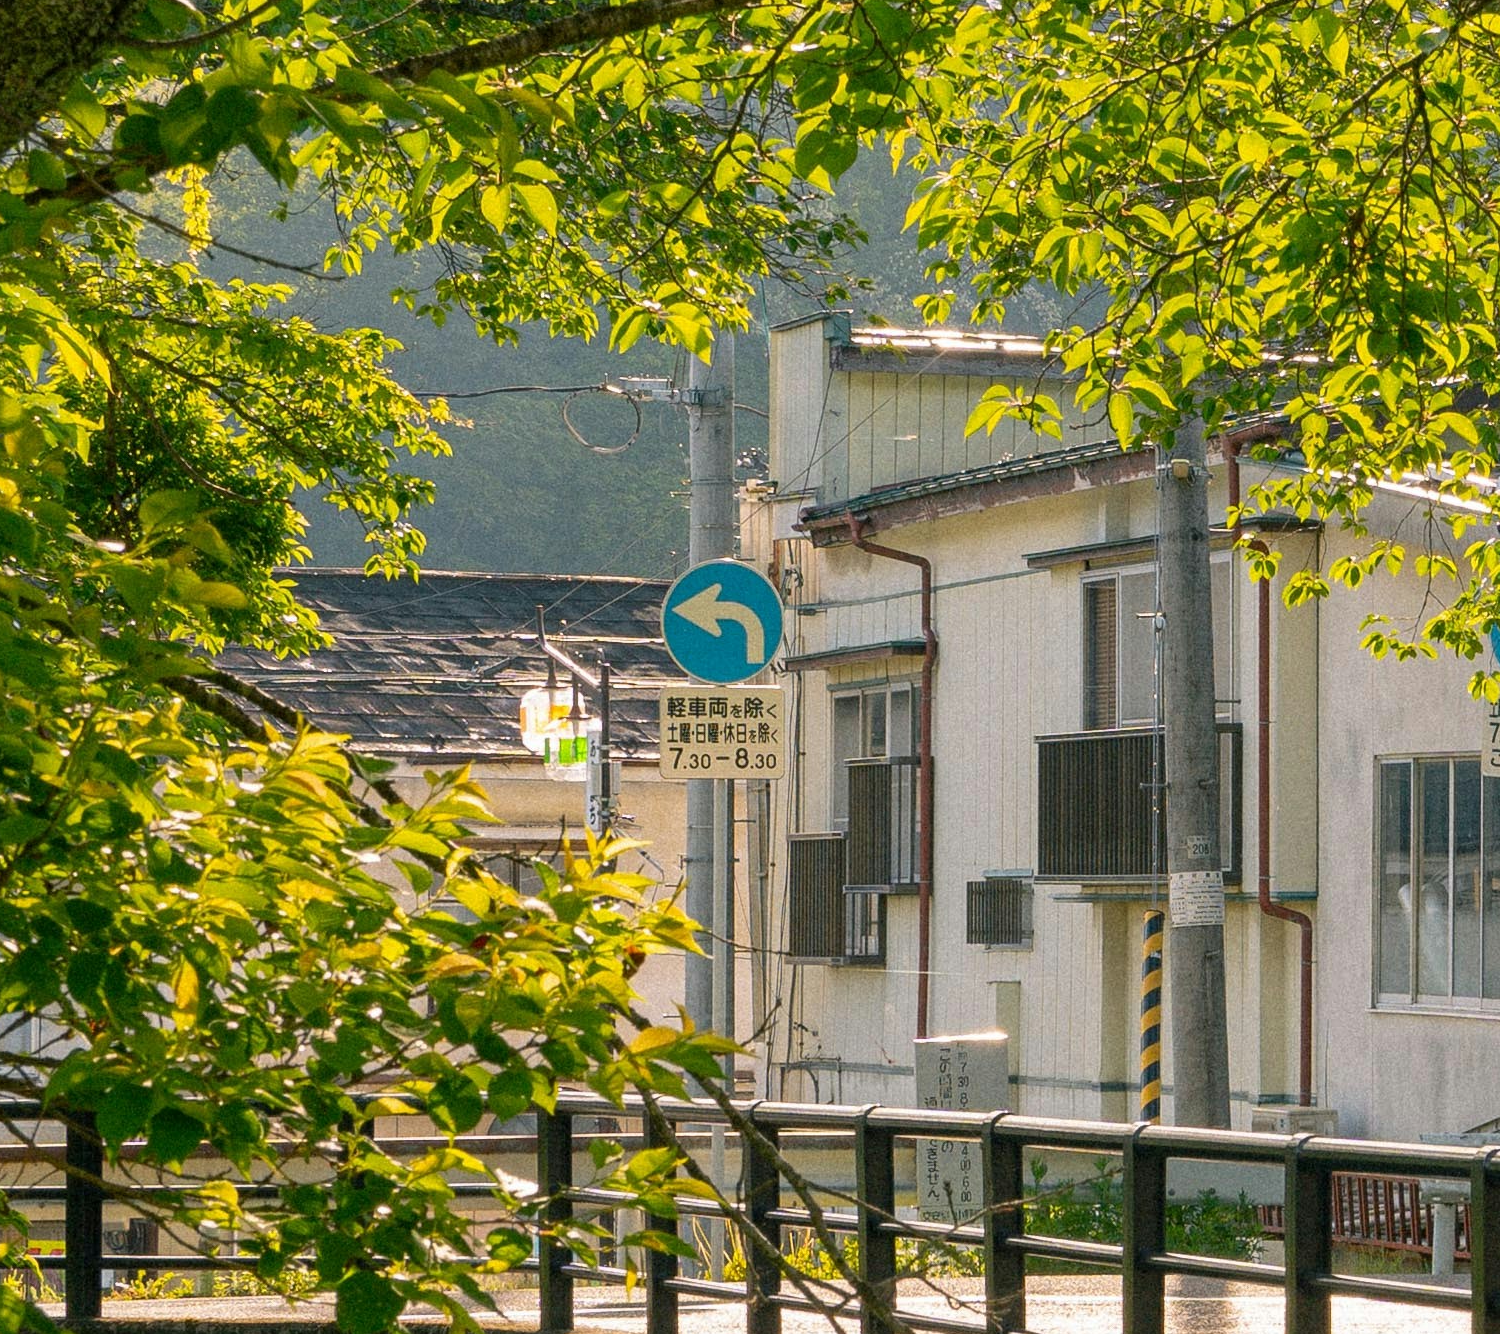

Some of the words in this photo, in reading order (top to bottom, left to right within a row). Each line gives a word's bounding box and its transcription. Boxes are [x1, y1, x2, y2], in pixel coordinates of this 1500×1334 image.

[667, 696, 777, 719] 軽車両を除く
